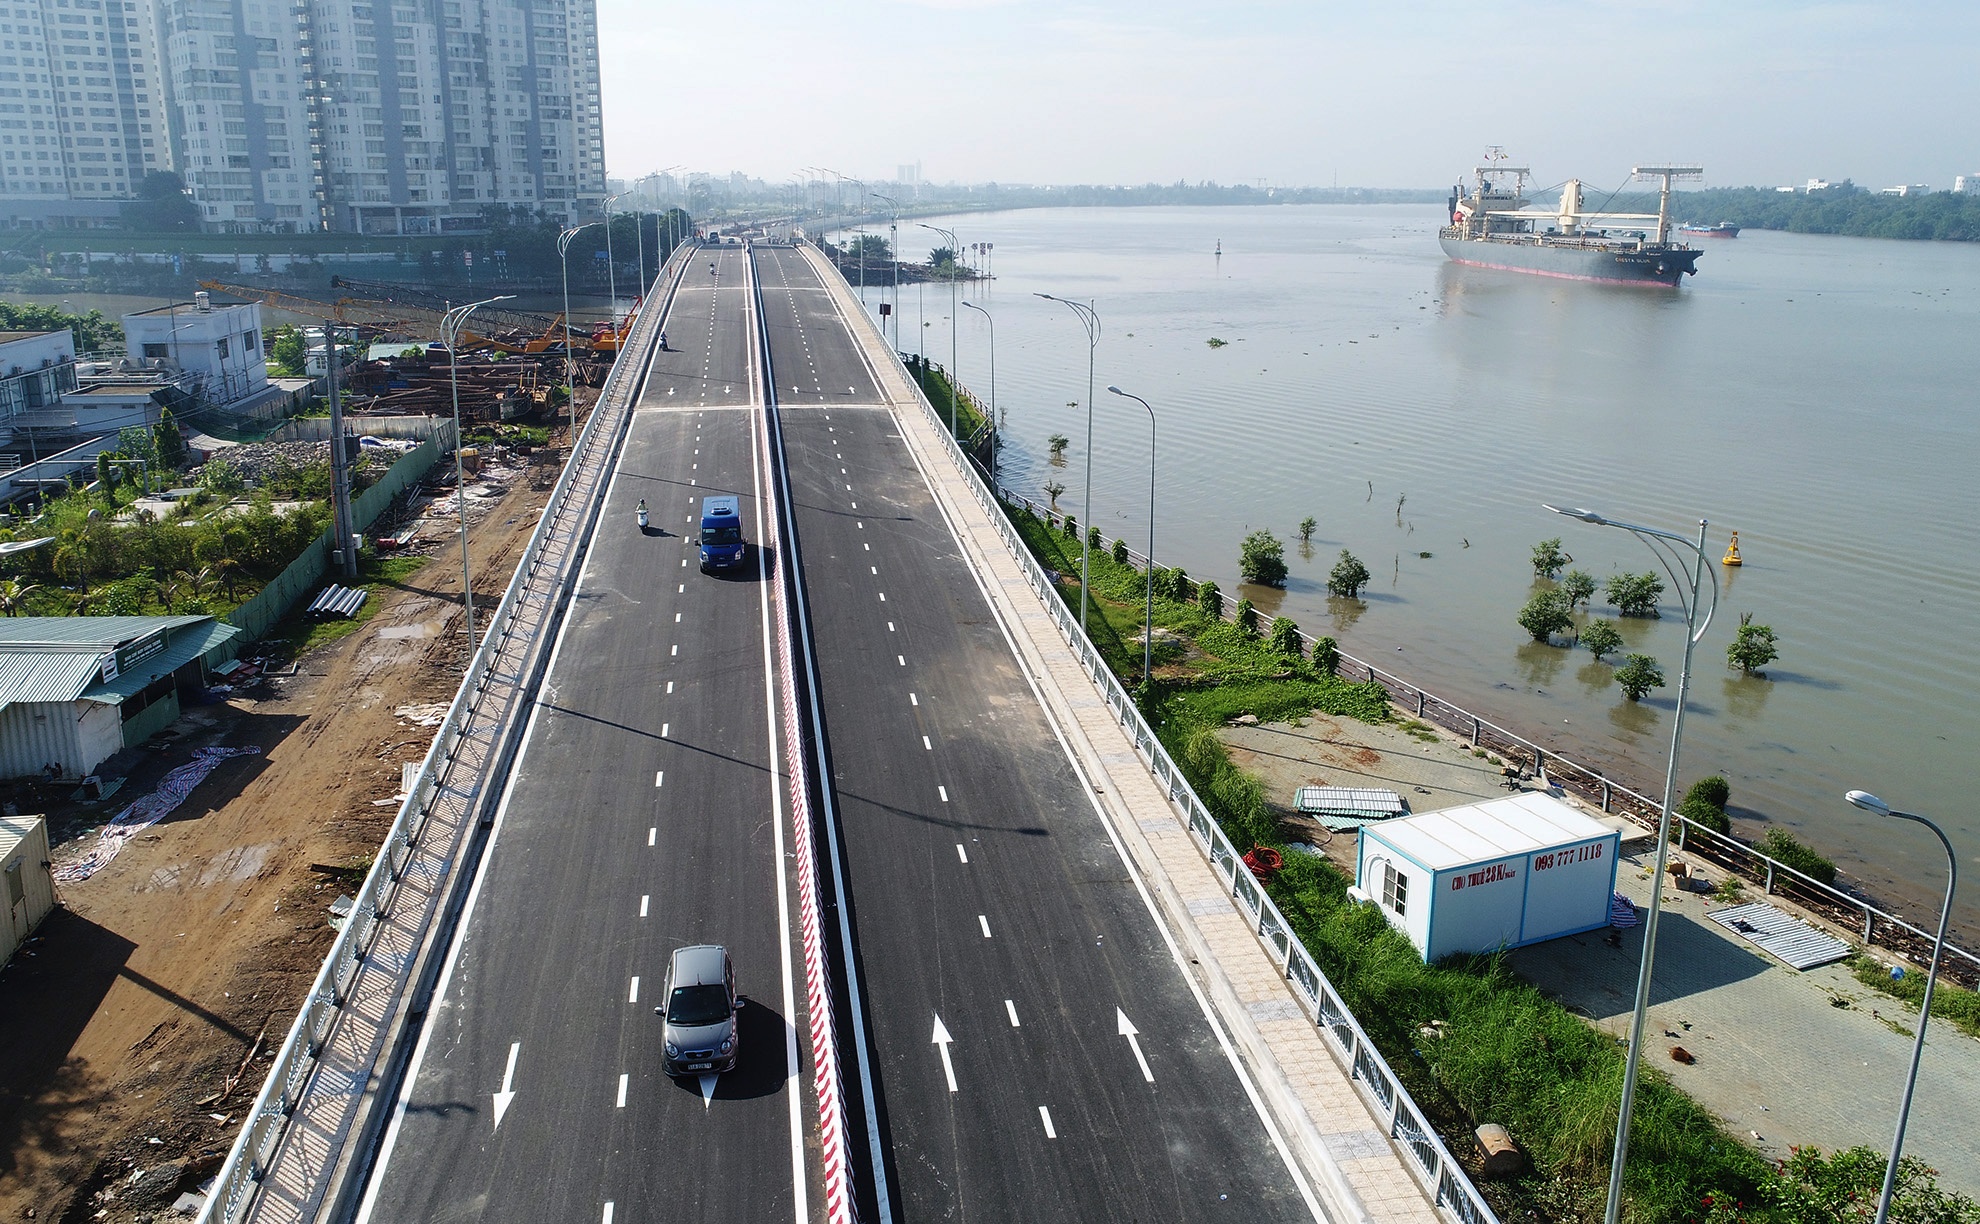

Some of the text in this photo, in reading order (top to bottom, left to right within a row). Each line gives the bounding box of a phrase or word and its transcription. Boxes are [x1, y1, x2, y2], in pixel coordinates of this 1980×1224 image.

[1534, 843, 1603, 871] 093 777 1118
[1451, 875, 1466, 891] CHO
[1468, 868, 1485, 887] THUÊ
